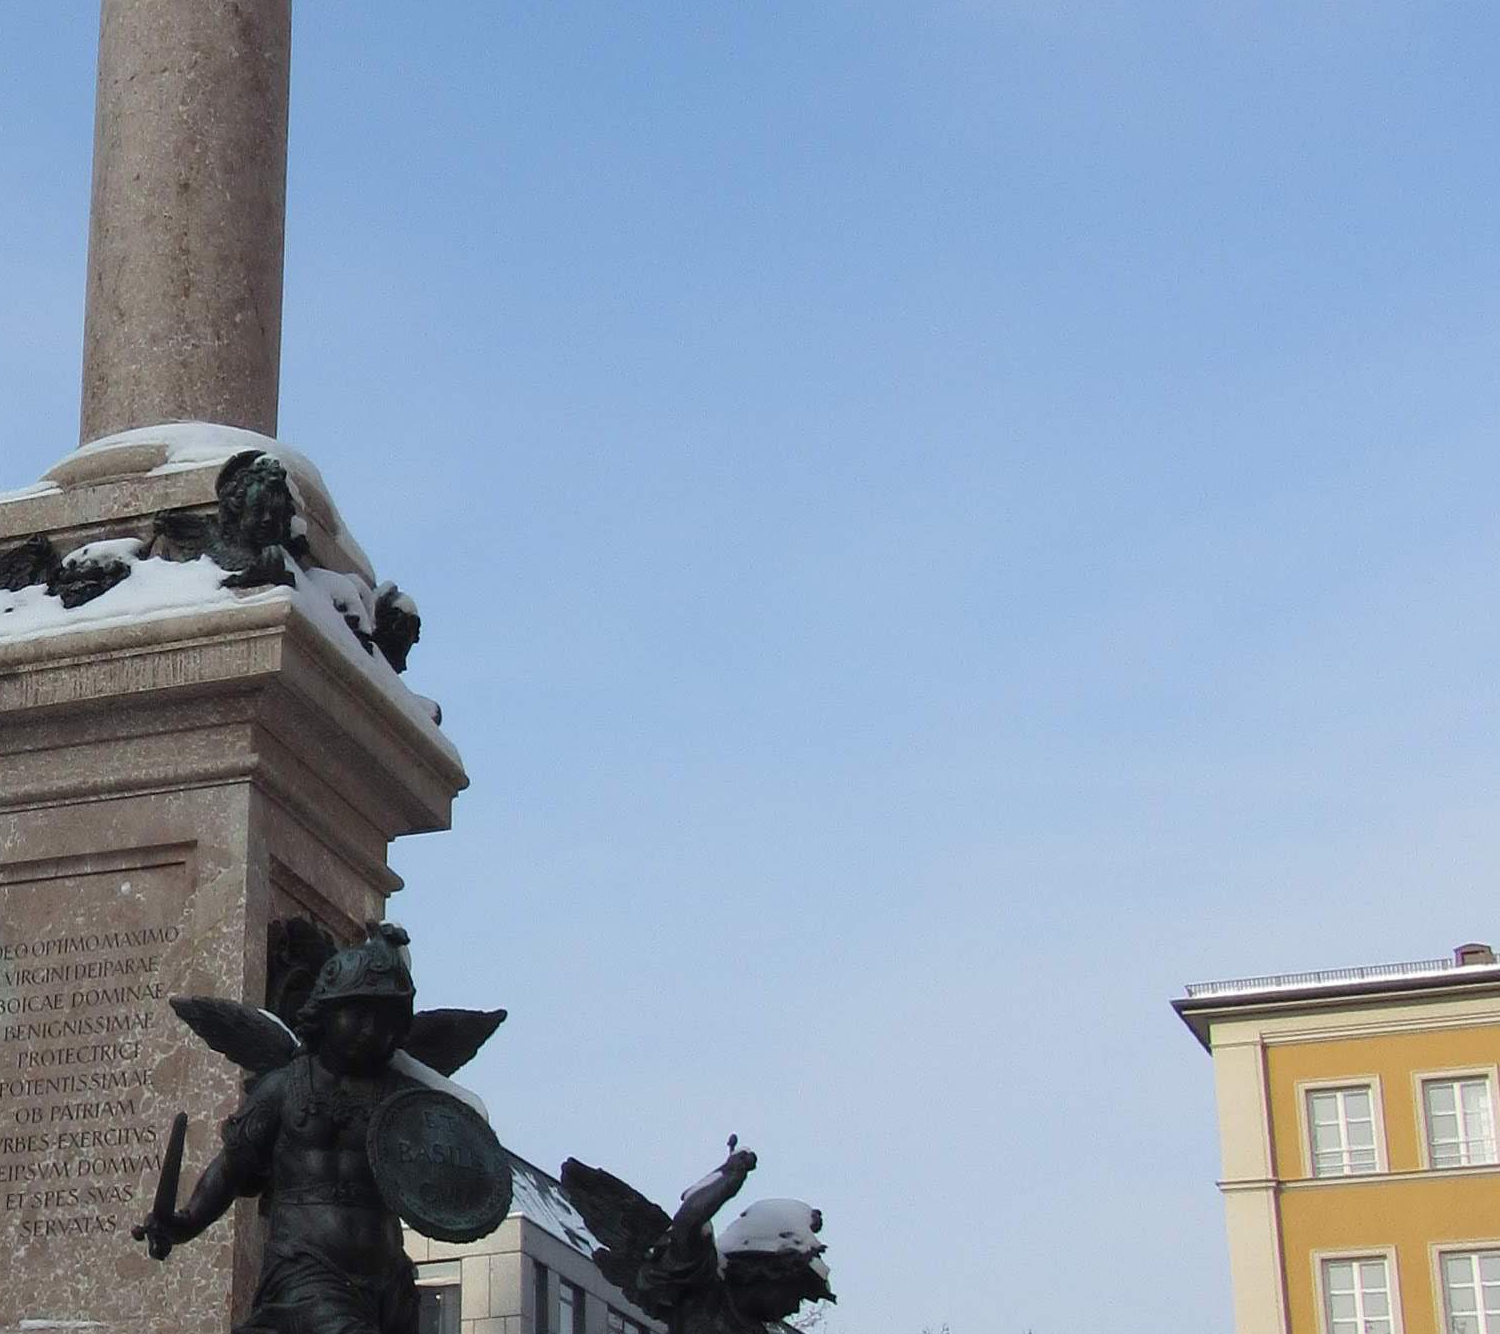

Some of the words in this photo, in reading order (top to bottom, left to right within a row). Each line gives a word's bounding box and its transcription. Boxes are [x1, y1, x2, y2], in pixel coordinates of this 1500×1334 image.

[31, 934, 99, 959] OPTIMO
[99, 925, 180, 951] MAXIMO
[4, 964, 74, 988] VIRGINI
[74, 955, 160, 980] DEIPARAE
[71, 982, 165, 1009] DOMINAE
[4, 1012, 155, 1043] BENIGNISSIMAE
[0, 1068, 154, 1098] POTENTISSIMAE
[14, 1108, 43, 1126] OB
[50, 1098, 136, 1122] PATRIAM
[77, 1154, 162, 1179] DOMVM
[6, 1192, 26, 1211] ET
[30, 1187, 80, 1210] SPES
[85, 1184, 134, 1206] SVAS
[19, 1214, 118, 1239] SERVATAS
